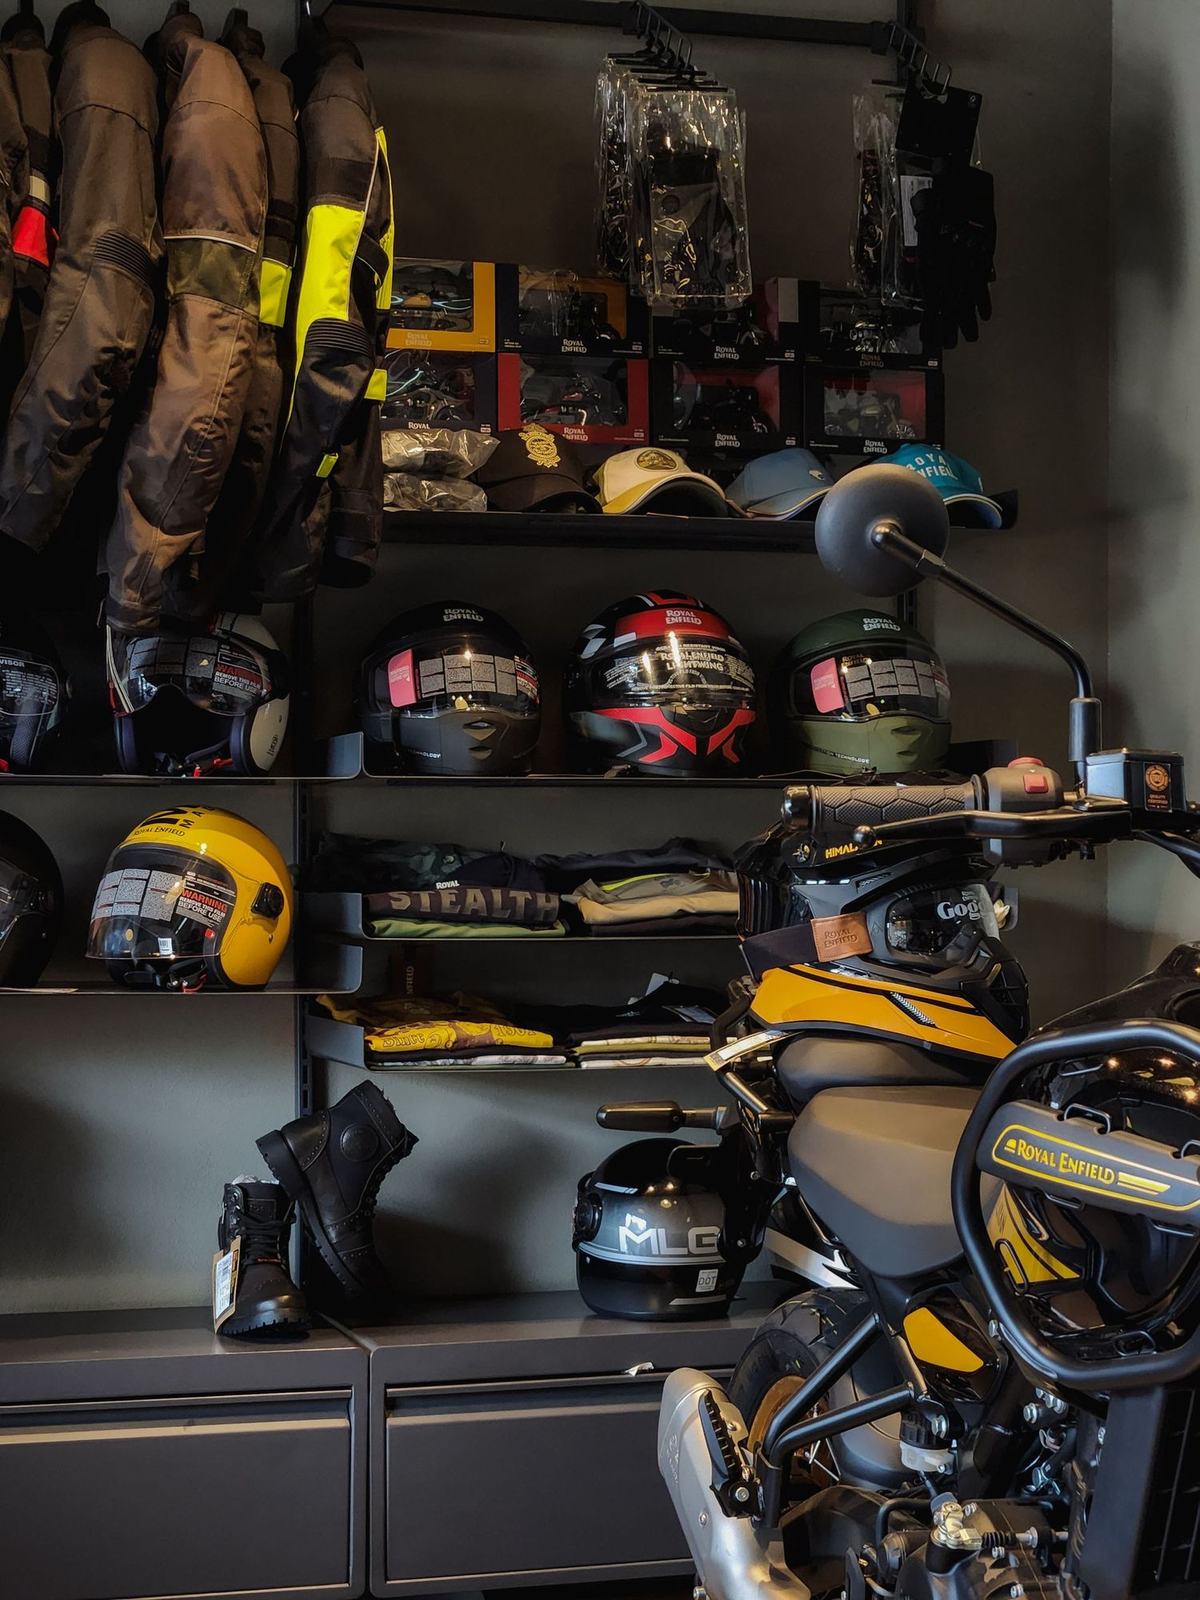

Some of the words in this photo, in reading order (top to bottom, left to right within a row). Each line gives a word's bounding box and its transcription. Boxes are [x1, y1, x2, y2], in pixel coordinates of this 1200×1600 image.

[407, 332, 429, 340] ROYAL
[405, 339, 432, 347] ENFIELD
[563, 338, 583, 347] ROYAL
[561, 345, 587, 354] ENFIELD
[715, 345, 736, 354] ROYAL
[714, 352, 740, 361] ENFIELD
[861, 353, 881, 361] ROYAL
[859, 360, 885, 368] ENFIELD
[408, 421, 430, 430] ROYAL
[564, 427, 585, 435] ROYAL
[716, 433, 737, 441] ROYAL
[714, 440, 741, 448] ENFIELD
[864, 439, 885, 447] ROYAL
[863, 446, 888, 454] ENFIELD
[442, 613, 485, 622] ENFIELD
[665, 609, 696, 618] ROYAL
[665, 616, 702, 625] ENFIELD
[862, 617, 896, 625] ROYAL
[862, 622, 901, 632] ENFIELD
[660, 650, 691, 661] ROAL
[214, 676, 245, 689] BEFORE
[154, 826, 185, 837] ENFIELD
[435, 879, 461, 890] ROYAL
[182, 888, 228, 912] WARNING
[388, 888, 560, 921] STEALTH
[178, 900, 208, 916] BEFORE
[208, 911, 223, 923] USE
[824, 927, 852, 940] ROYAL
[823, 934, 858, 949] ENFIELD
[1016, 1138, 1057, 1168] ROYAL
[1058, 1151, 1116, 1185] ENFIELD
[618, 1225, 720, 1255] MLG
[698, 1275, 717, 1286] DOT
